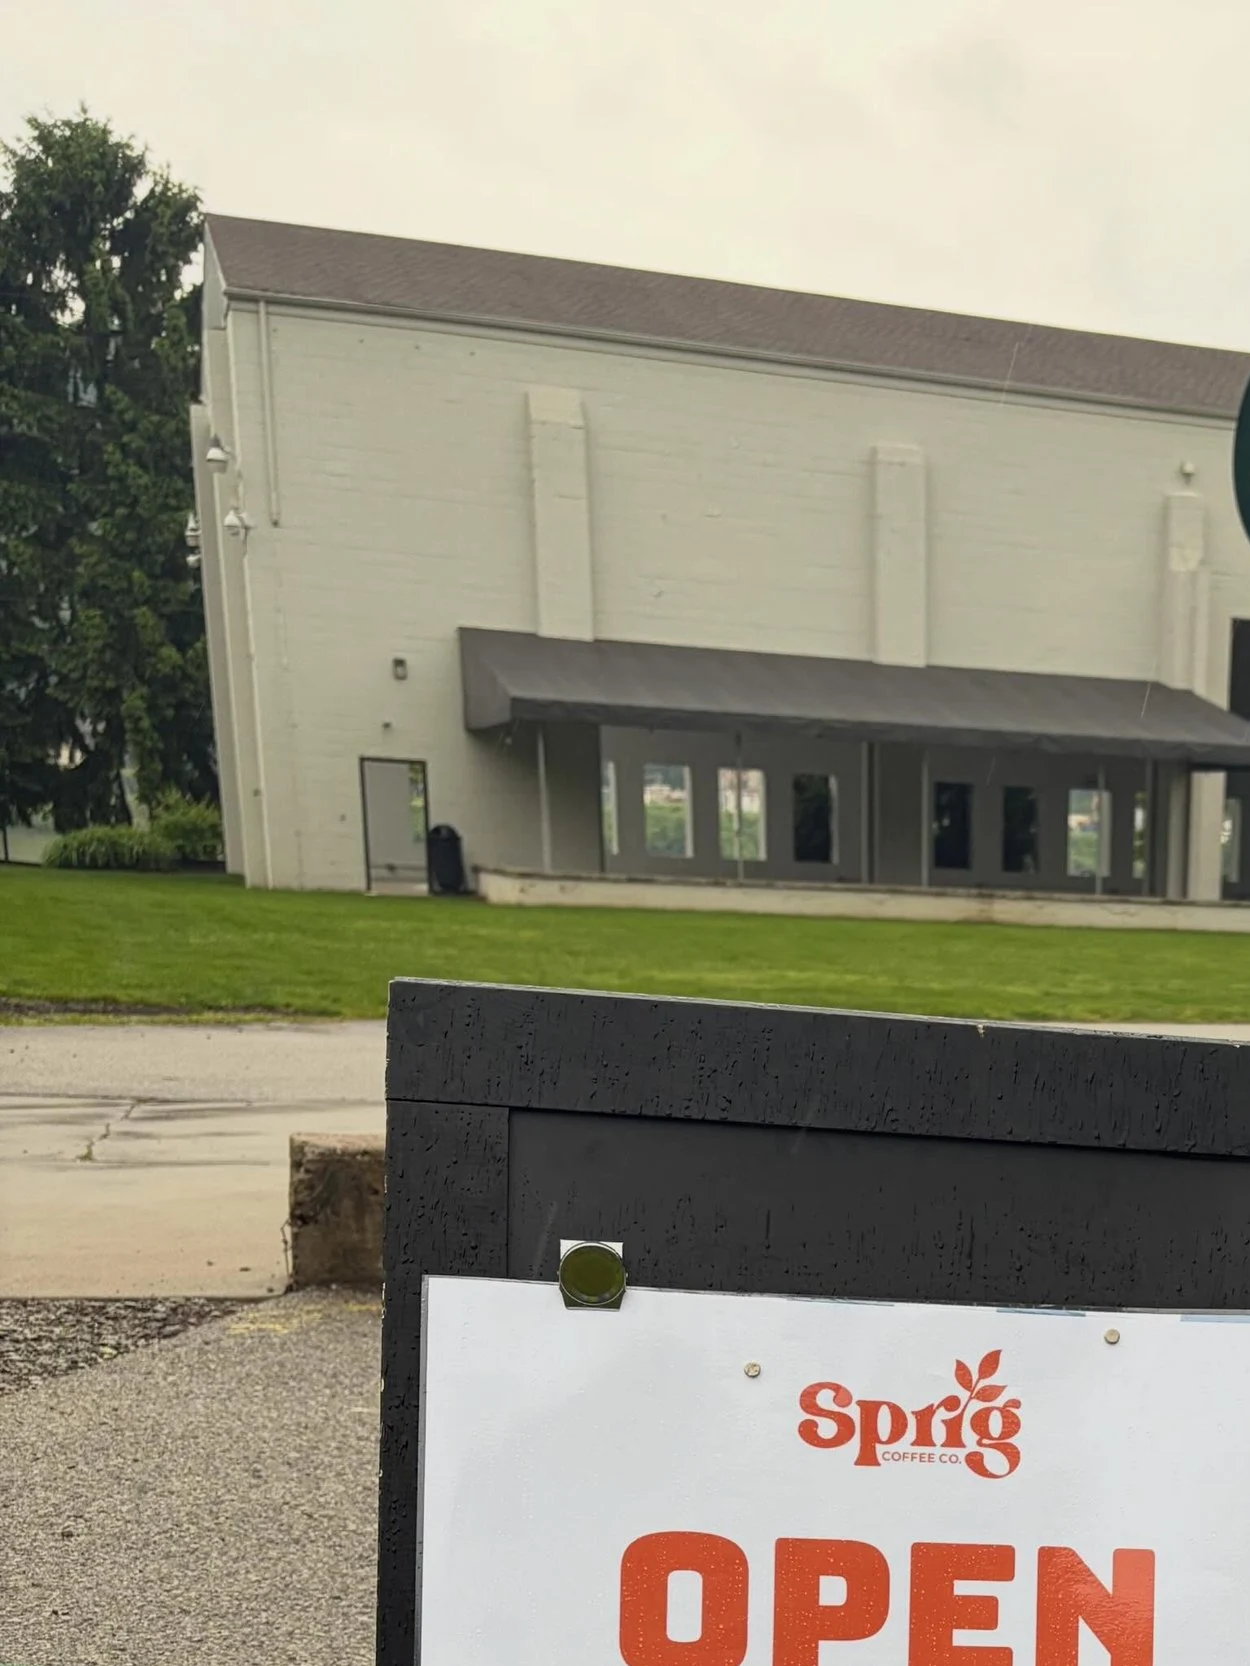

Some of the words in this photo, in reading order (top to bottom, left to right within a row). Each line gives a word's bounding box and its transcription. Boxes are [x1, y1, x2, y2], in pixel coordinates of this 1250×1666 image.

[797, 1350, 1021, 1480] Sprig
[881, 1451, 936, 1463] COFFEE
[938, 1453, 962, 1464] CO.
